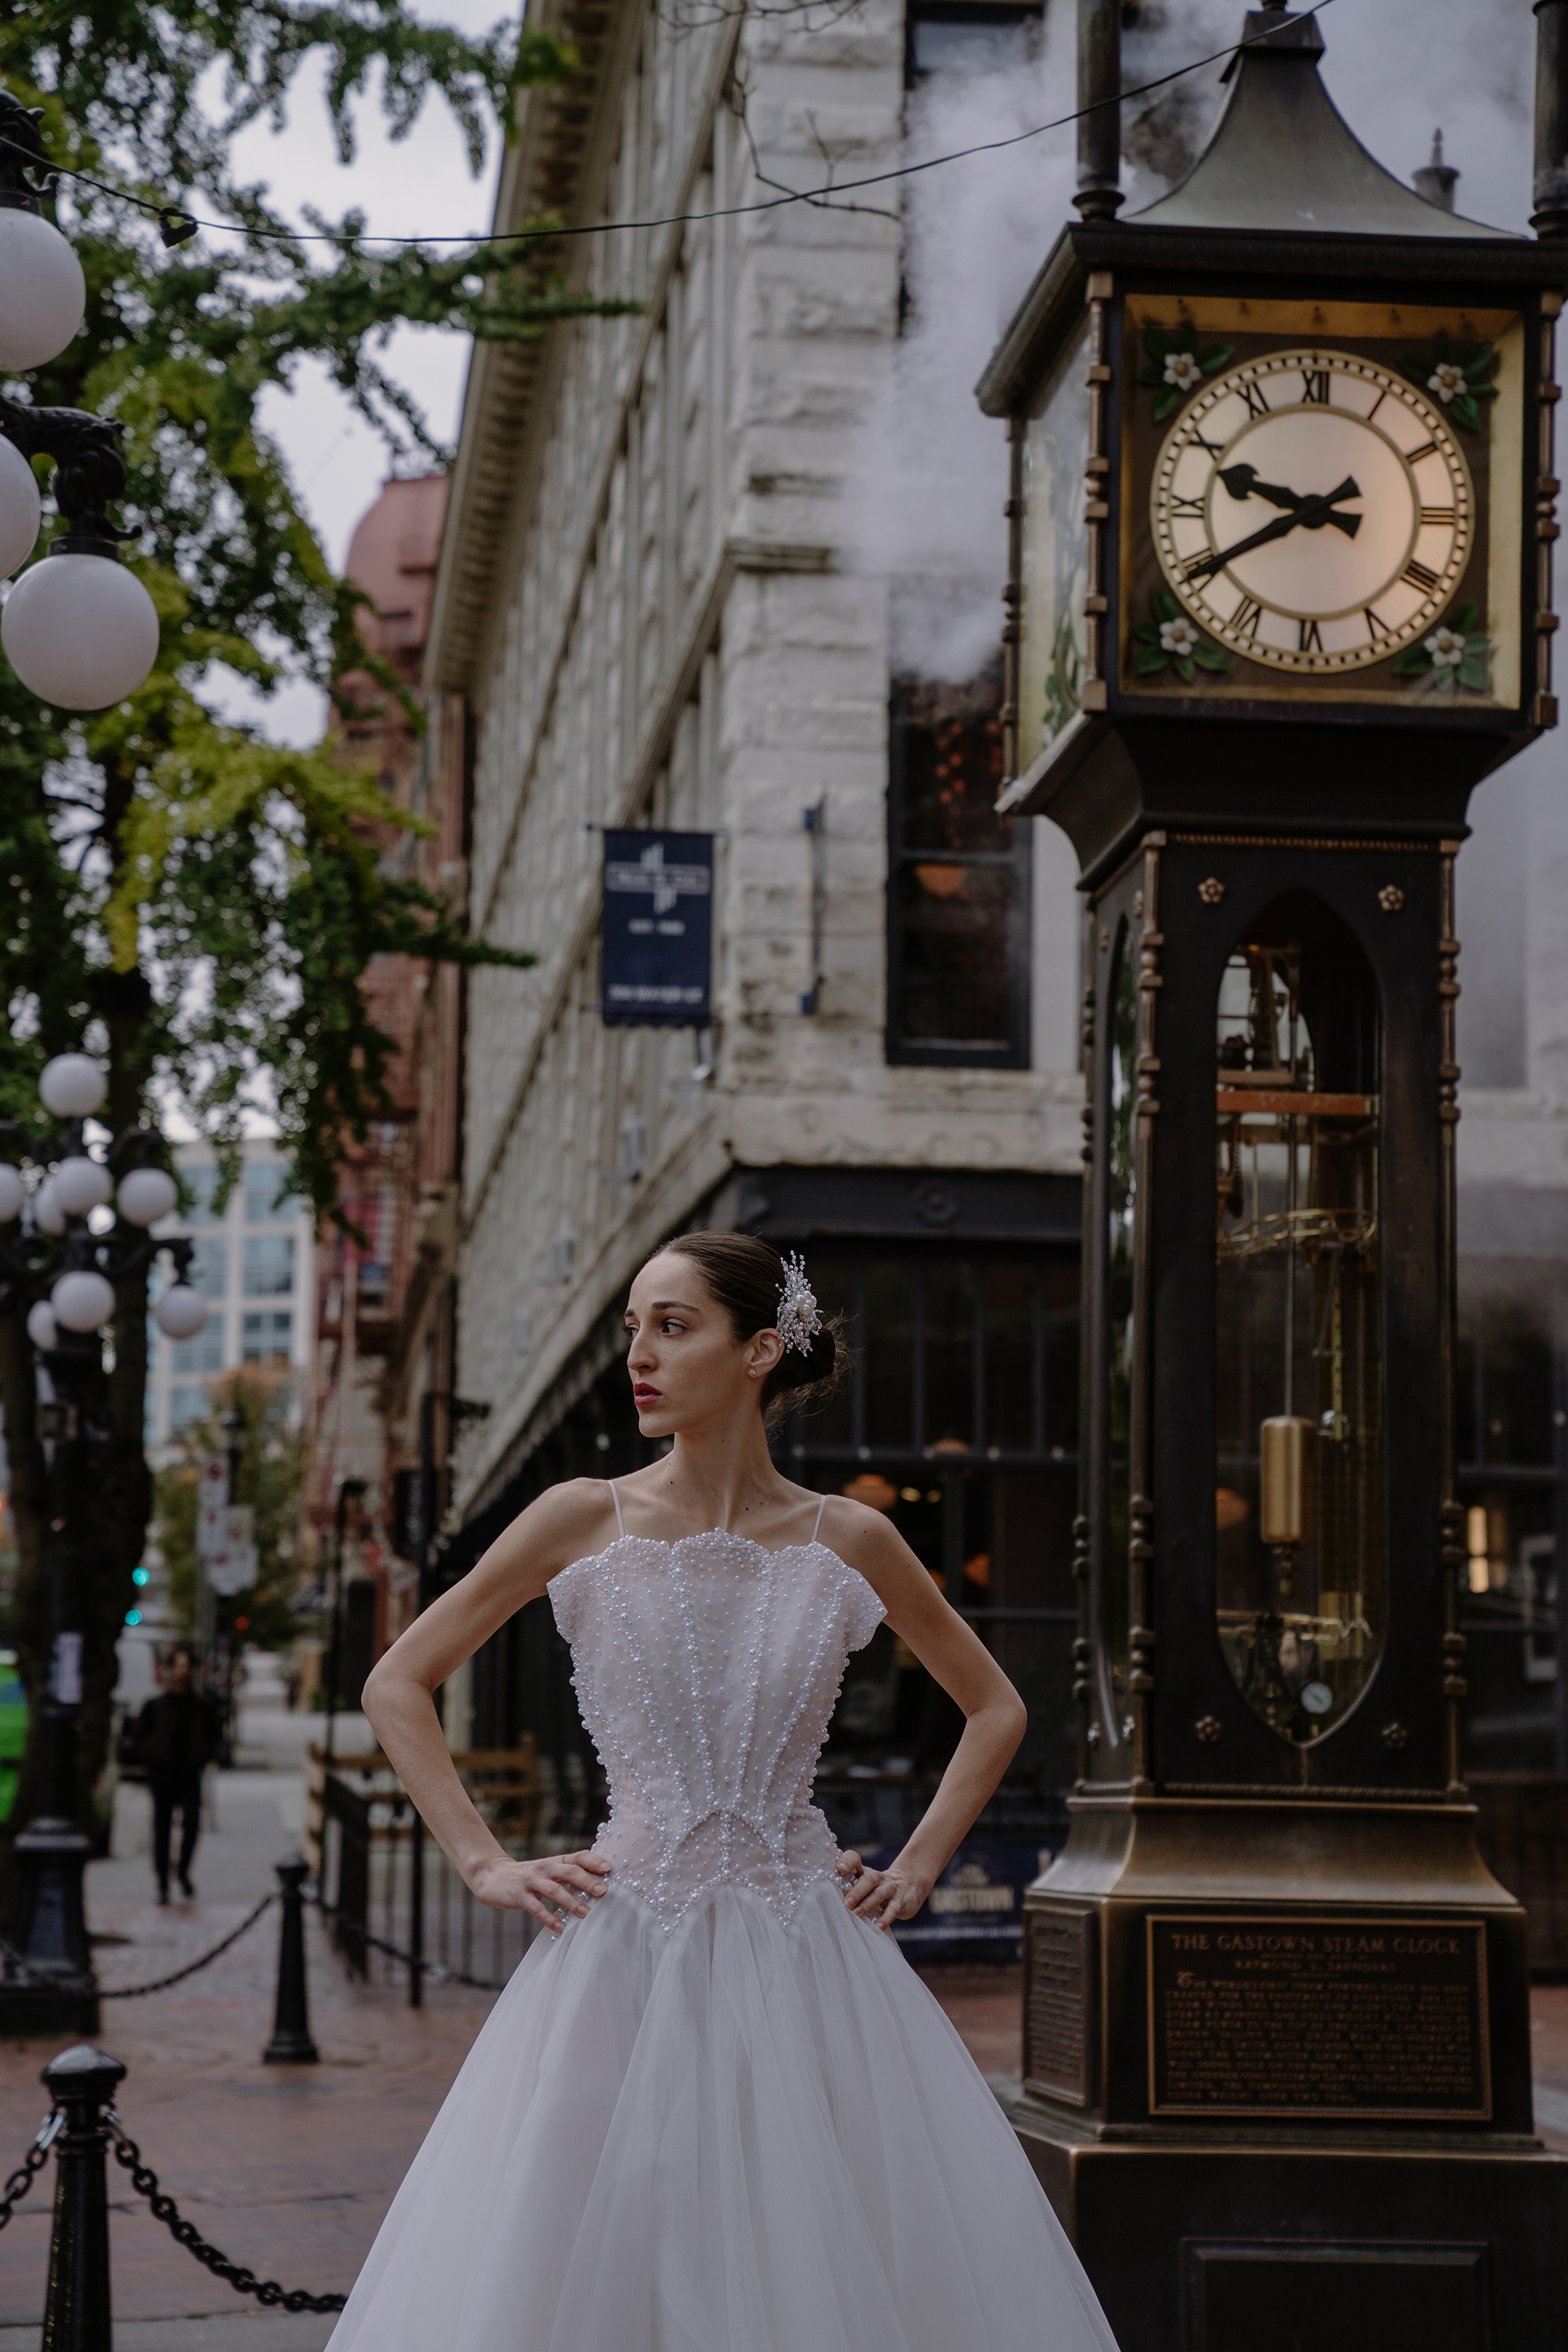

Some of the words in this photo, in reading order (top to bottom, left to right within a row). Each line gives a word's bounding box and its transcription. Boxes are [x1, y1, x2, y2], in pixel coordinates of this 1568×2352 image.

[1171, 1934, 1211, 1950] THE
[1216, 1934, 1315, 1951] GASTOWN
[1323, 1936, 1386, 1953] STEAM
[1392, 1938, 1461, 1955] CLOCK
